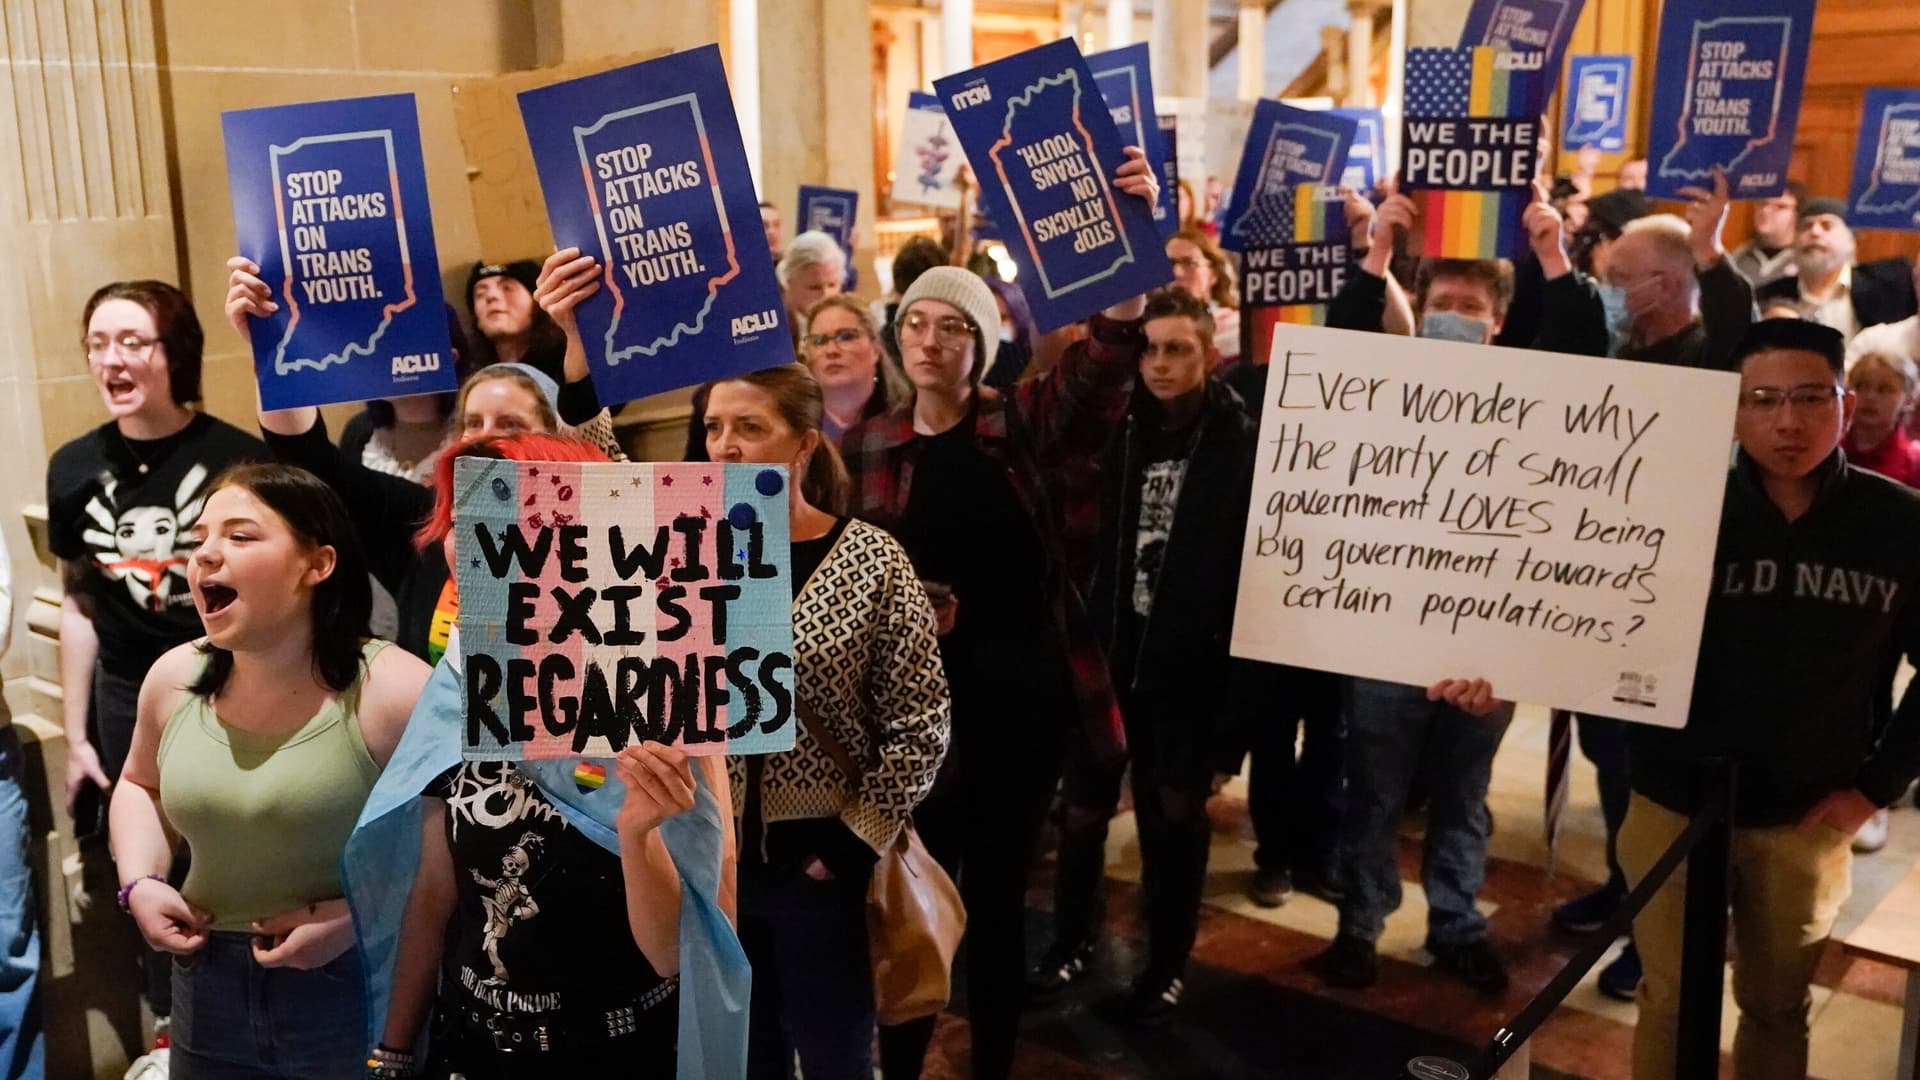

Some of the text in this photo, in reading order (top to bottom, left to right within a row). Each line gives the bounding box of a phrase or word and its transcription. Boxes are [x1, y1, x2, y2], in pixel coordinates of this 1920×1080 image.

[1494, 51, 1543, 70] ACLU
[1701, 42, 1745, 60] STOP
[1698, 60, 1774, 79] ATTACKS
[951, 84, 992, 111] ACLU
[1696, 80, 1721, 97] ON
[1695, 98, 1750, 116] TRANS
[1408, 123, 1533, 144] WE THE
[1693, 117, 1751, 136] YOUTH.
[595, 143, 652, 179] STOP
[1016, 131, 1081, 168] YOUTH.
[287, 170, 342, 198] STOP
[604, 160, 700, 207] ATTACKS
[1031, 153, 1090, 191] TRANS
[1406, 149, 1530, 186] PEOPLE
[1070, 175, 1098, 202] ON
[292, 192, 387, 225] ATTACKS
[609, 204, 644, 234] ON
[1033, 197, 1105, 242] ATTACKS
[294, 225, 327, 251] ON
[614, 221, 692, 261] TRANS
[1074, 220, 1116, 254] STOP
[296, 248, 372, 278] TRANS
[622, 249, 706, 289] YOUTH.
[1247, 245, 1346, 268] WE THE
[301, 275, 383, 304] YOUTH.
[1246, 268, 1346, 302] PEOPLE
[731, 309, 778, 337] ACLU
[392, 353, 440, 375] ACLU
[1278, 350, 1660, 462] Ever wonder why
[1270, 423, 1642, 504] the party of small
[1265, 488, 1665, 571] government LOVES being
[474, 517, 778, 583] WE WILL
[1256, 525, 1657, 603] big government towards
[1721, 559, 1899, 613] LD NAVY
[506, 583, 741, 646] EXIST
[1283, 578, 1645, 648] certain populations?
[466, 646, 793, 754] REGARDLESS
[460, 965, 477, 991] THE
[507, 991, 561, 1013] PARADE
